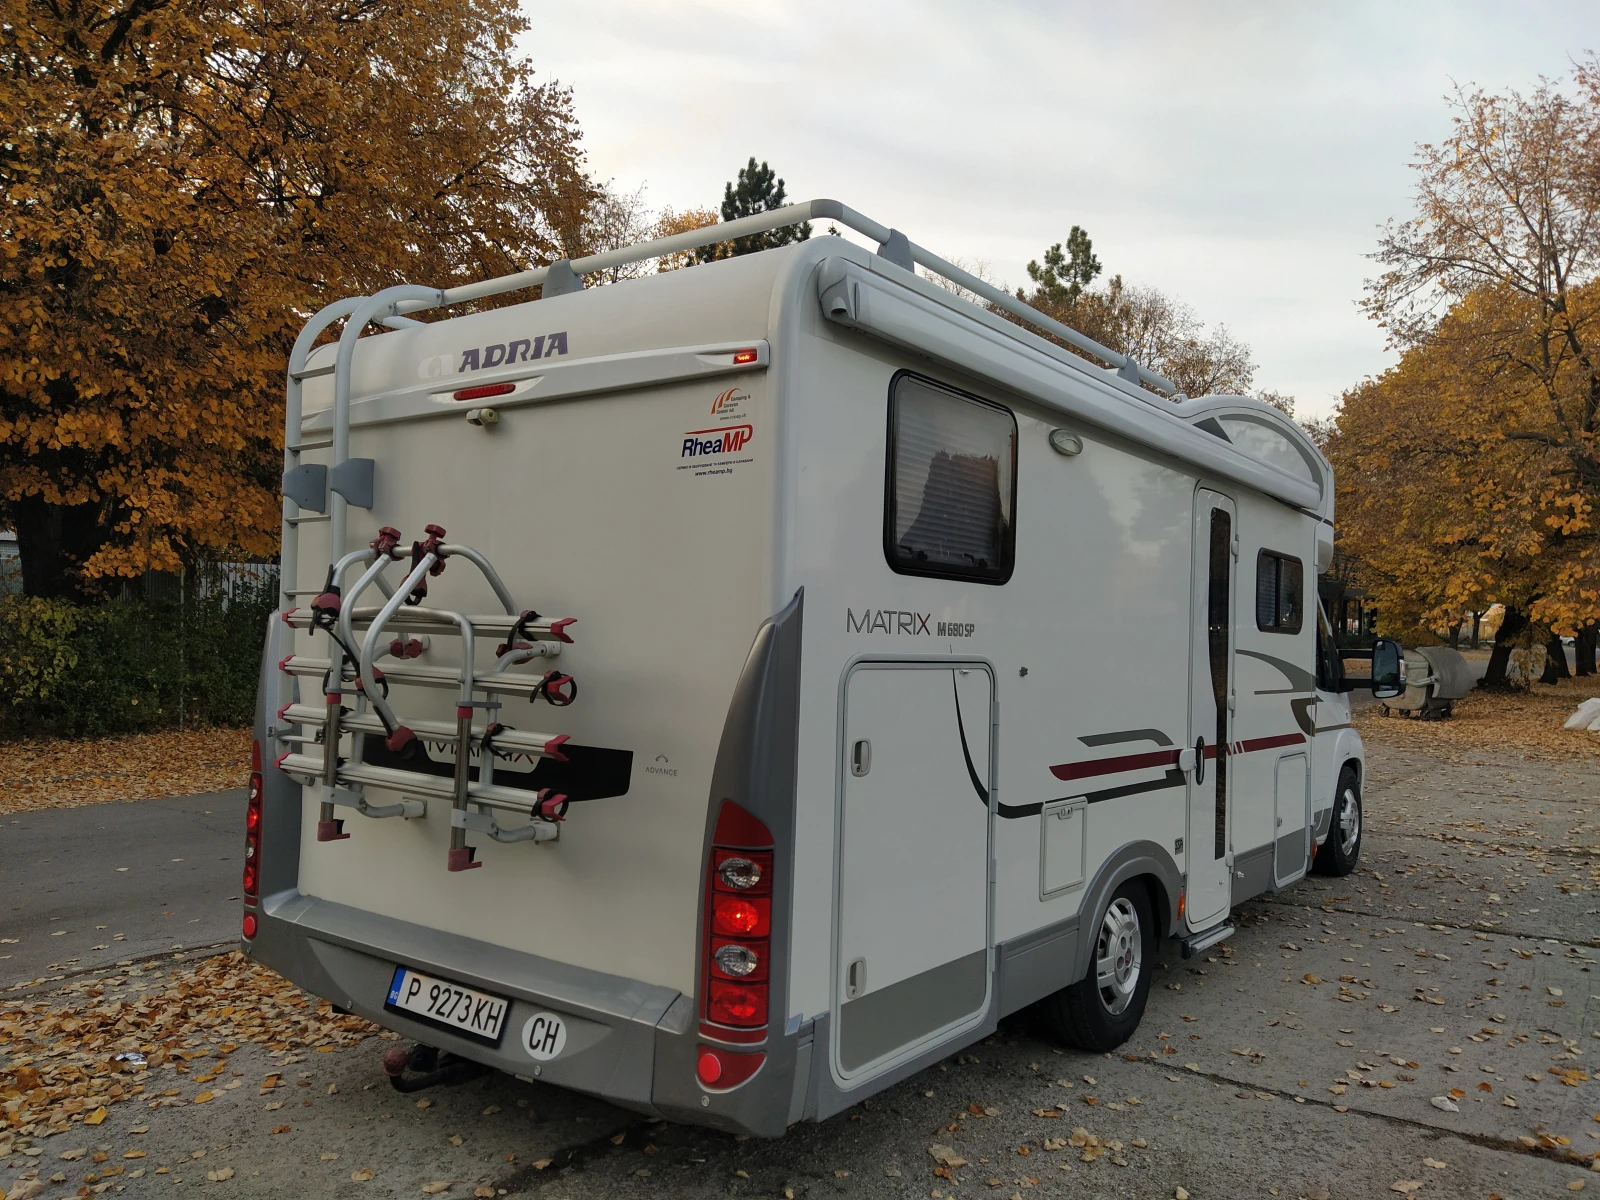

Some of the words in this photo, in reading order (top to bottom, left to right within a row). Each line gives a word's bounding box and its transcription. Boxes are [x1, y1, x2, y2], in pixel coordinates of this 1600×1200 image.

[458, 331, 568, 373] ADRIA
[681, 424, 753, 458] RheaMP
[846, 607, 931, 636] MATRIX
[645, 766, 678, 777] ADVANCE
[528, 1017, 560, 1054] CH
